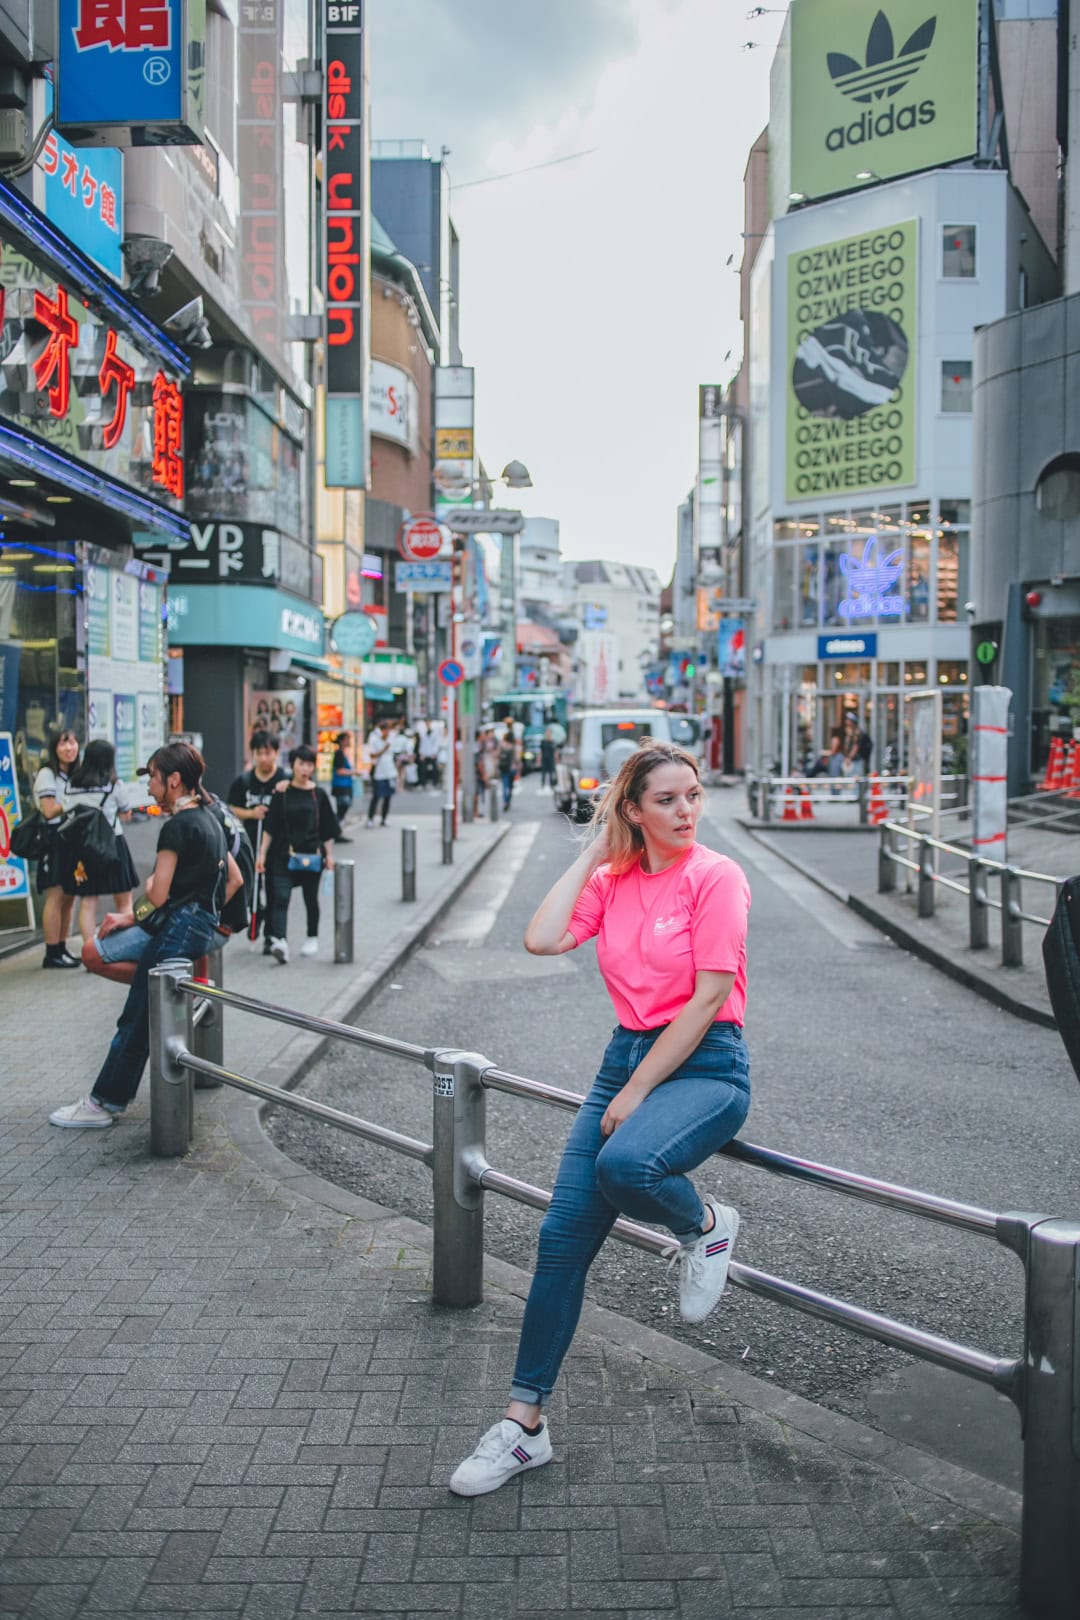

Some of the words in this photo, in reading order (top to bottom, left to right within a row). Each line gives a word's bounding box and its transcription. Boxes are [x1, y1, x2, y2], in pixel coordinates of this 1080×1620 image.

[328, 5, 360, 22] B1F
[328, 60, 352, 150] disk
[825, 99, 936, 151] adidas
[327, 173, 360, 346] union
[797, 230, 904, 275] OZWEEGO
[797, 256, 904, 299] OZWEEGO
[797, 282, 904, 324] OZWEEGO
[796, 410, 903, 445] OZWEEGO
[796, 435, 903, 469] OZWEEGO
[796, 461, 903, 493] OZWEEGO
